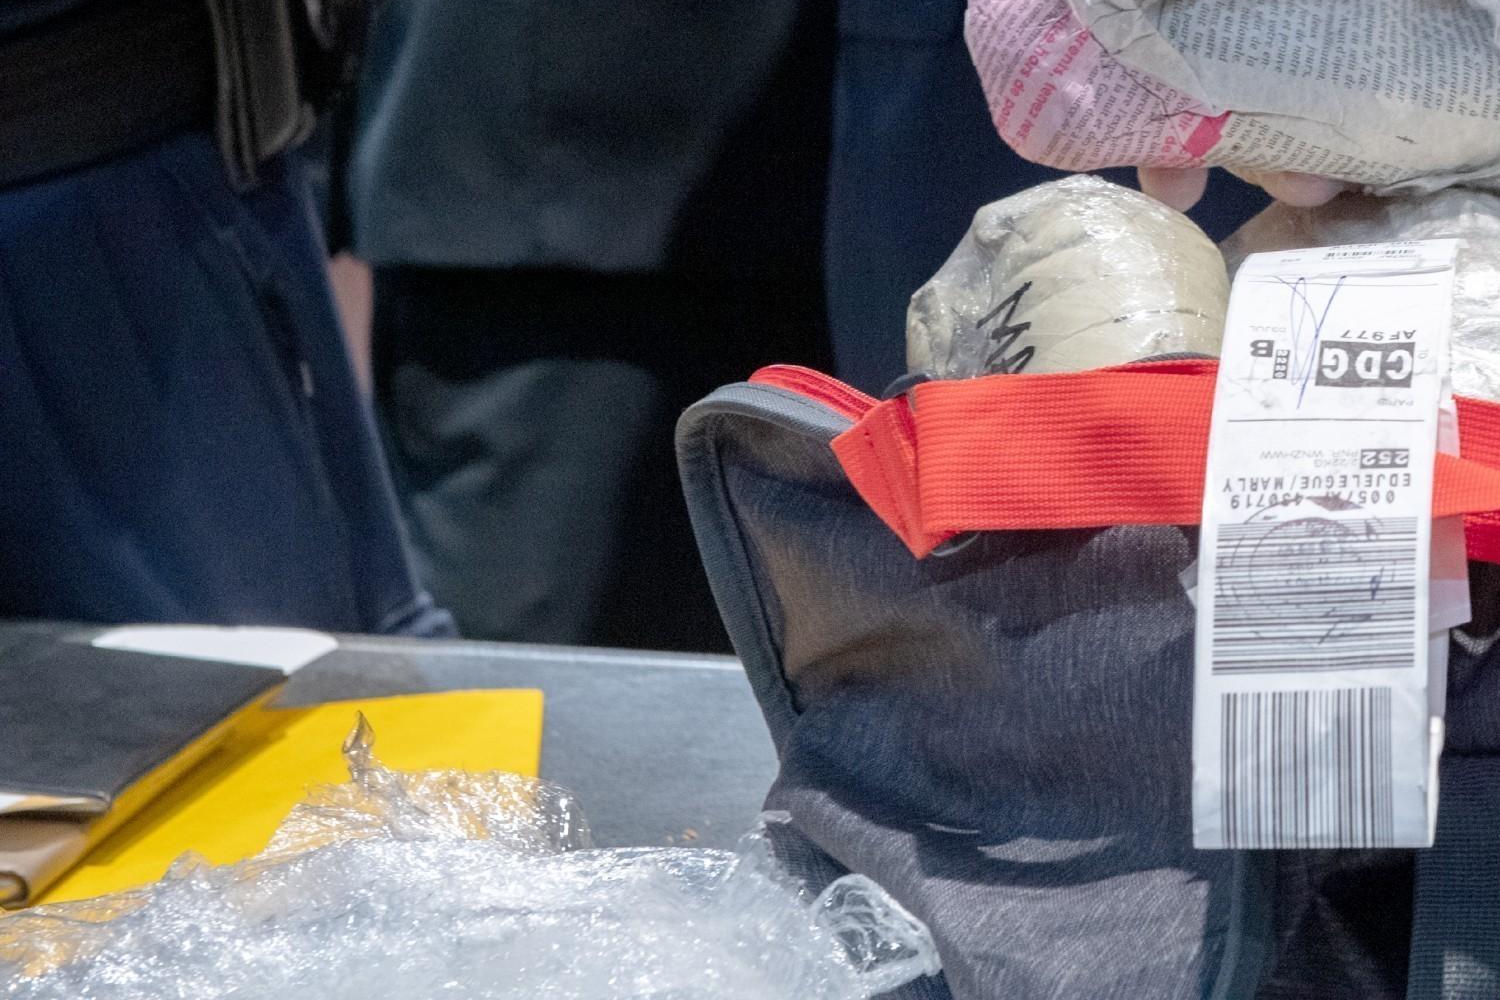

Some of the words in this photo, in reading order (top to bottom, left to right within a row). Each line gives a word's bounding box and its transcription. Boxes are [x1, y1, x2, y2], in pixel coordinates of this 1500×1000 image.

[1008, 77, 1027, 99] de
[1026, 81, 1058, 120] tenez
[1248, 339, 1275, 357] B
[1320, 346, 1412, 380] CDG
[1360, 450, 1409, 465] 252
[1220, 472, 1411, 492] EDJELEGUE/MARLY
